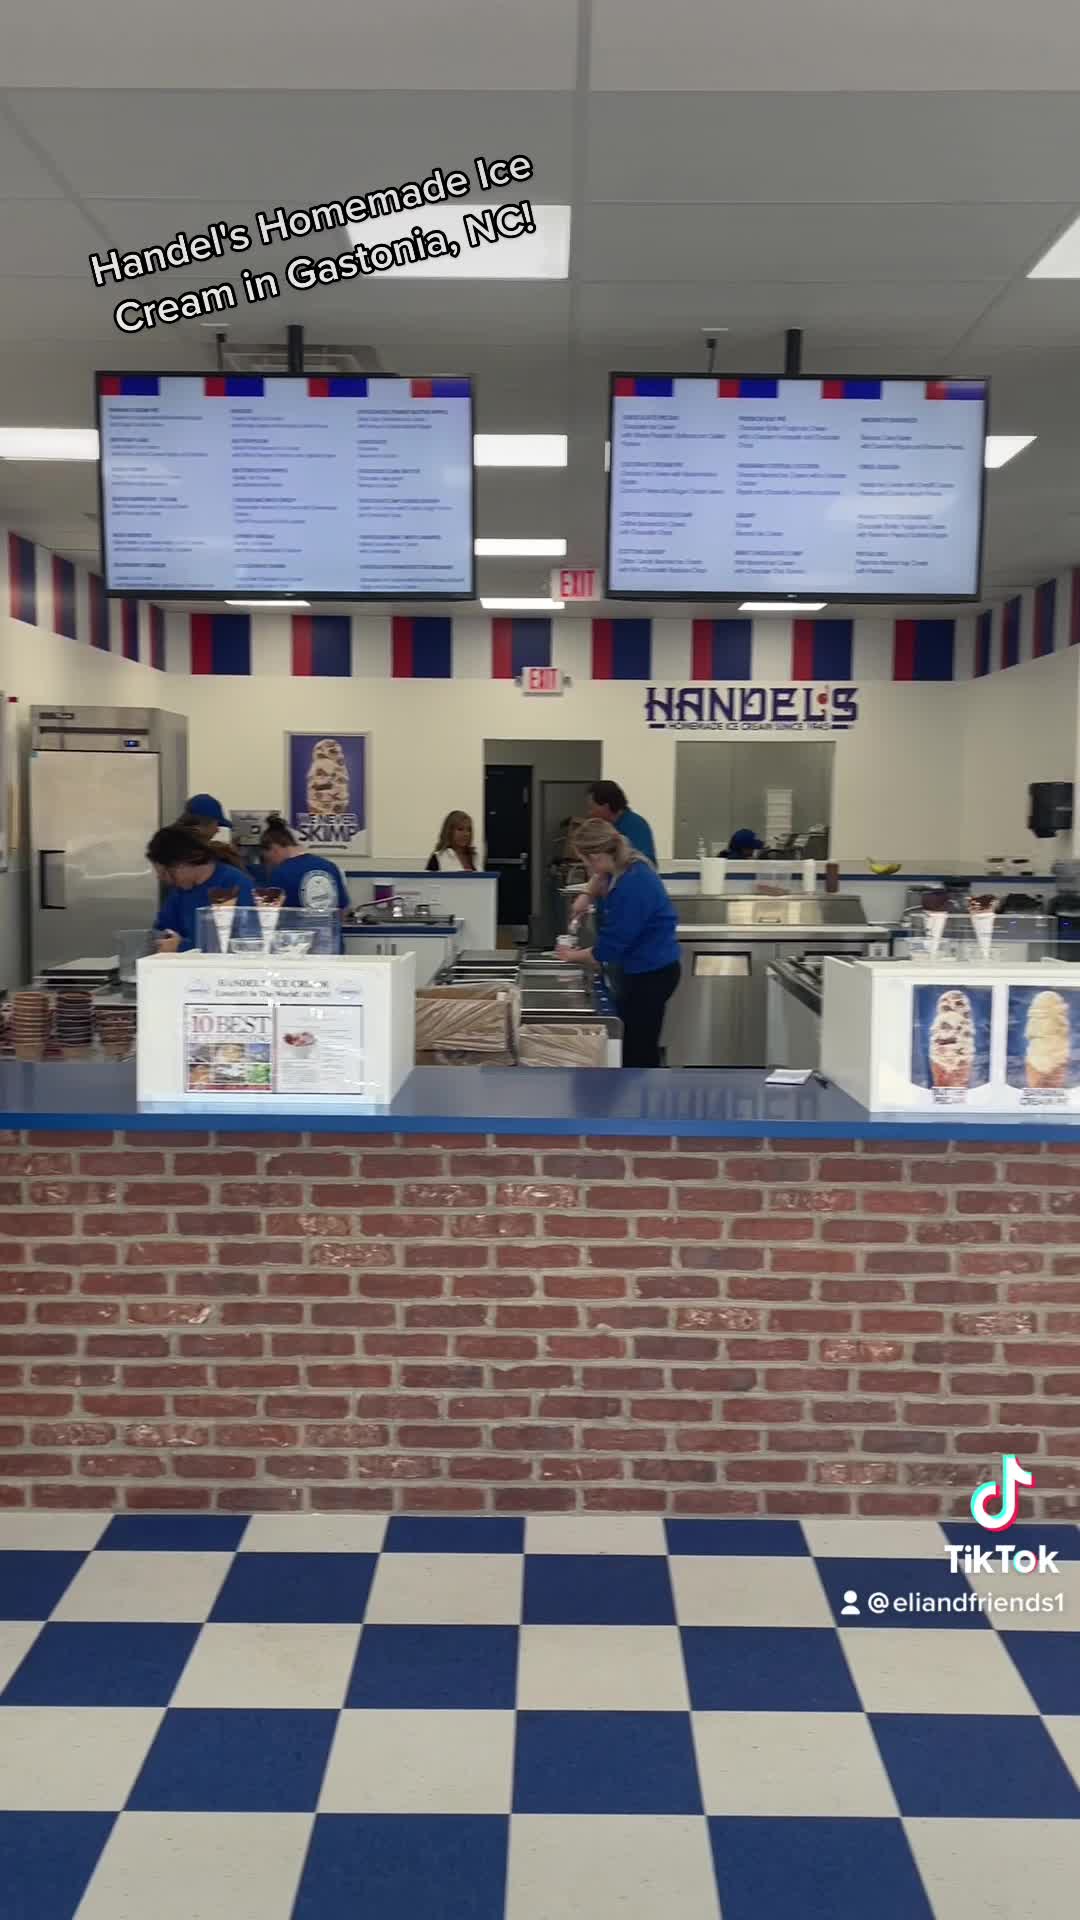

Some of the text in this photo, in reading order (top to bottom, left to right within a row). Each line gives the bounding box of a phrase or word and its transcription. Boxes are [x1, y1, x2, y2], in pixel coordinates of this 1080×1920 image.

[560, 569, 595, 598] EXIT
[529, 668, 557, 690] EXIT
[298, 825, 359, 842] SKIMP
[191, 1015, 272, 1034] 10 BEST
